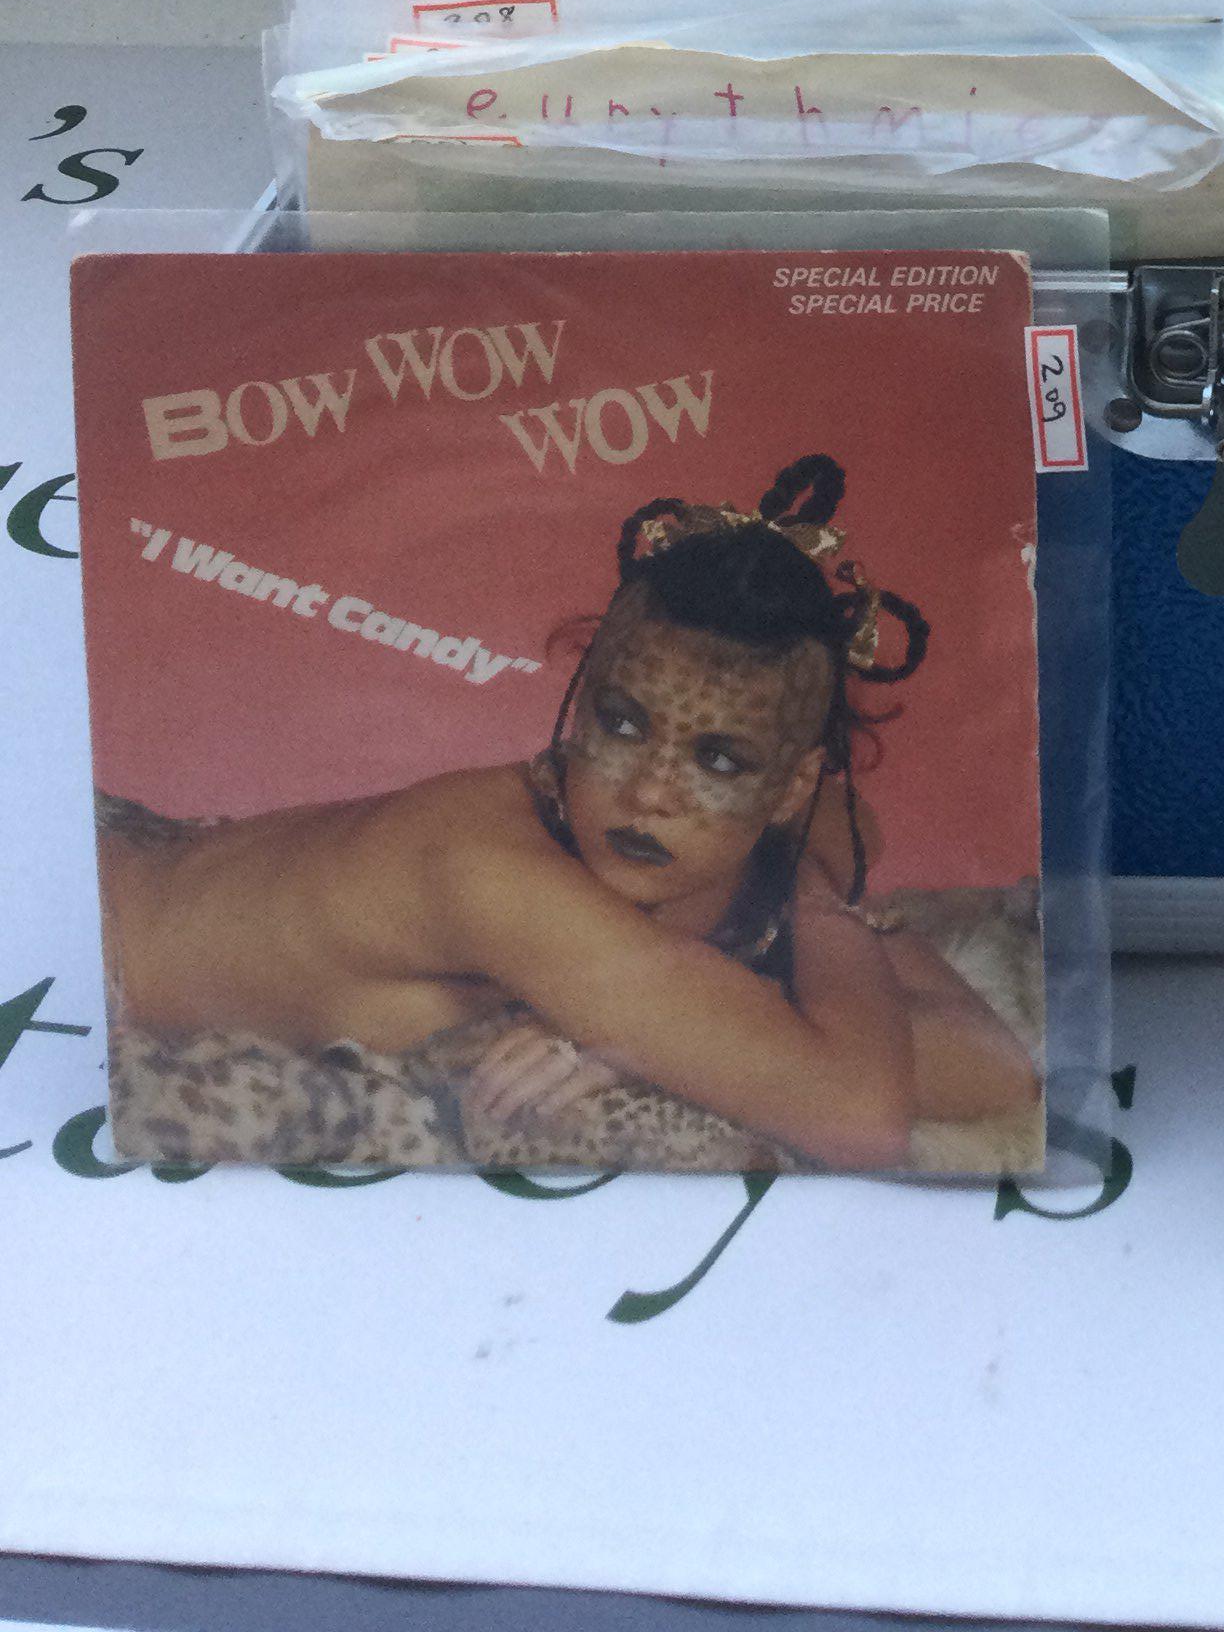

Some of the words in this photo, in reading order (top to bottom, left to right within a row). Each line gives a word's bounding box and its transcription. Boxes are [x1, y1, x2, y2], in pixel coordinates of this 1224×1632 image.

[773, 267, 881, 288] SPECIAL
[891, 265, 1000, 287] EDITION
[788, 294, 898, 315] SPECIAL
[907, 293, 985, 314] PRICE
[142, 369, 357, 462] BOW
[365, 320, 567, 402] WOW
[500, 371, 715, 475] WOW
[1041, 354, 1067, 423] 209
[171, 537, 330, 619] Want
